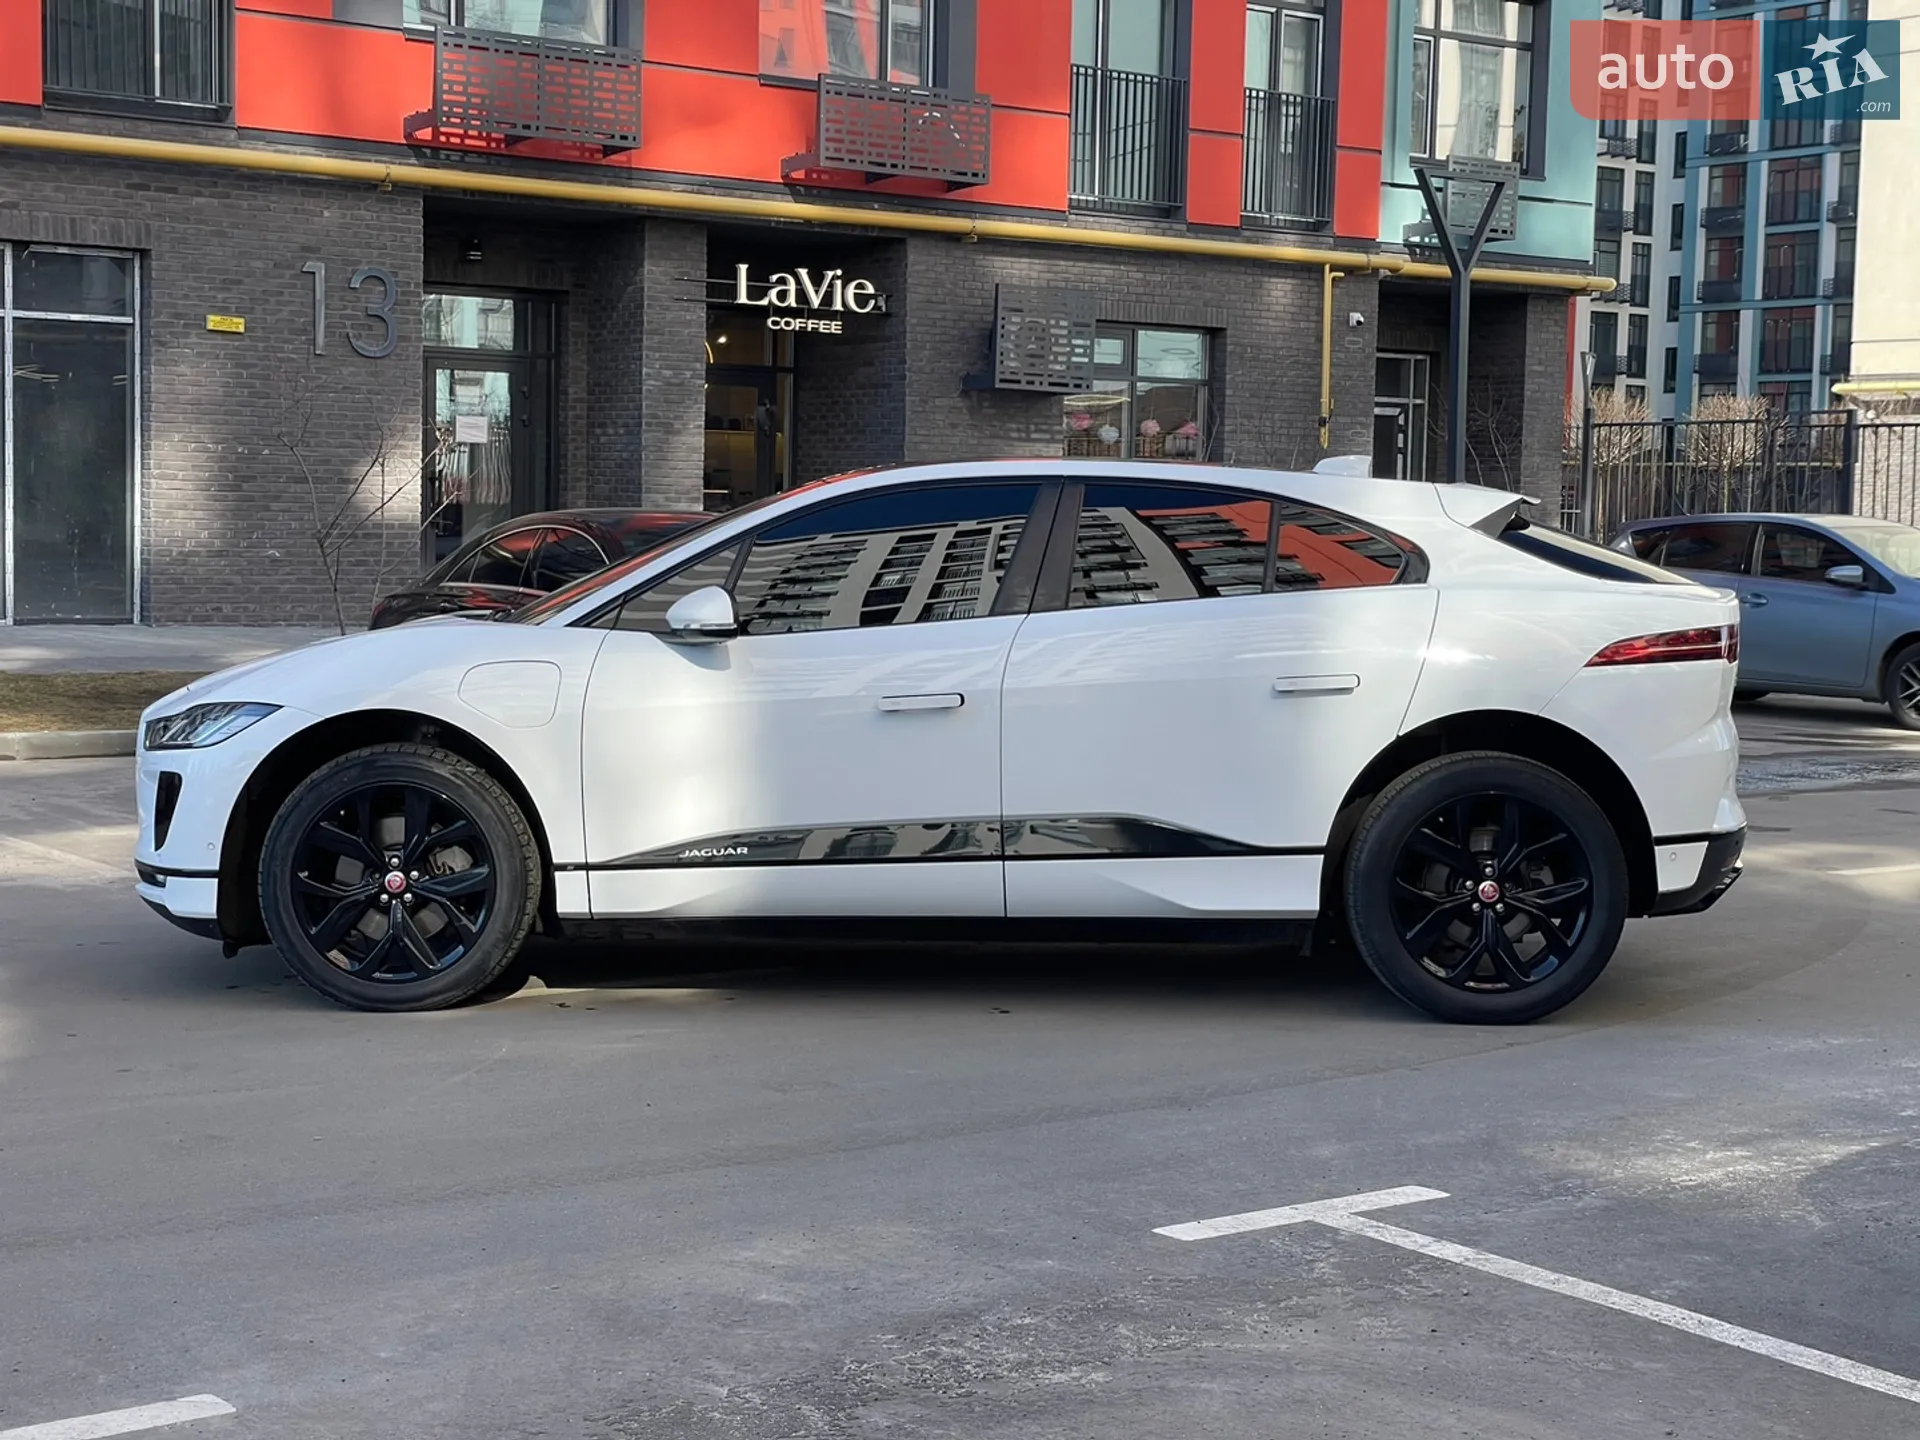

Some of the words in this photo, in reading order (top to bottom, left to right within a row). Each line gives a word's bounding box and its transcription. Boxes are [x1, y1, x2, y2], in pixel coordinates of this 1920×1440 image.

[734, 263, 876, 313] LaVie
[301, 261, 398, 359] 13
[766, 316, 843, 334] COFFEE
[678, 846, 749, 858] JAGUAR
